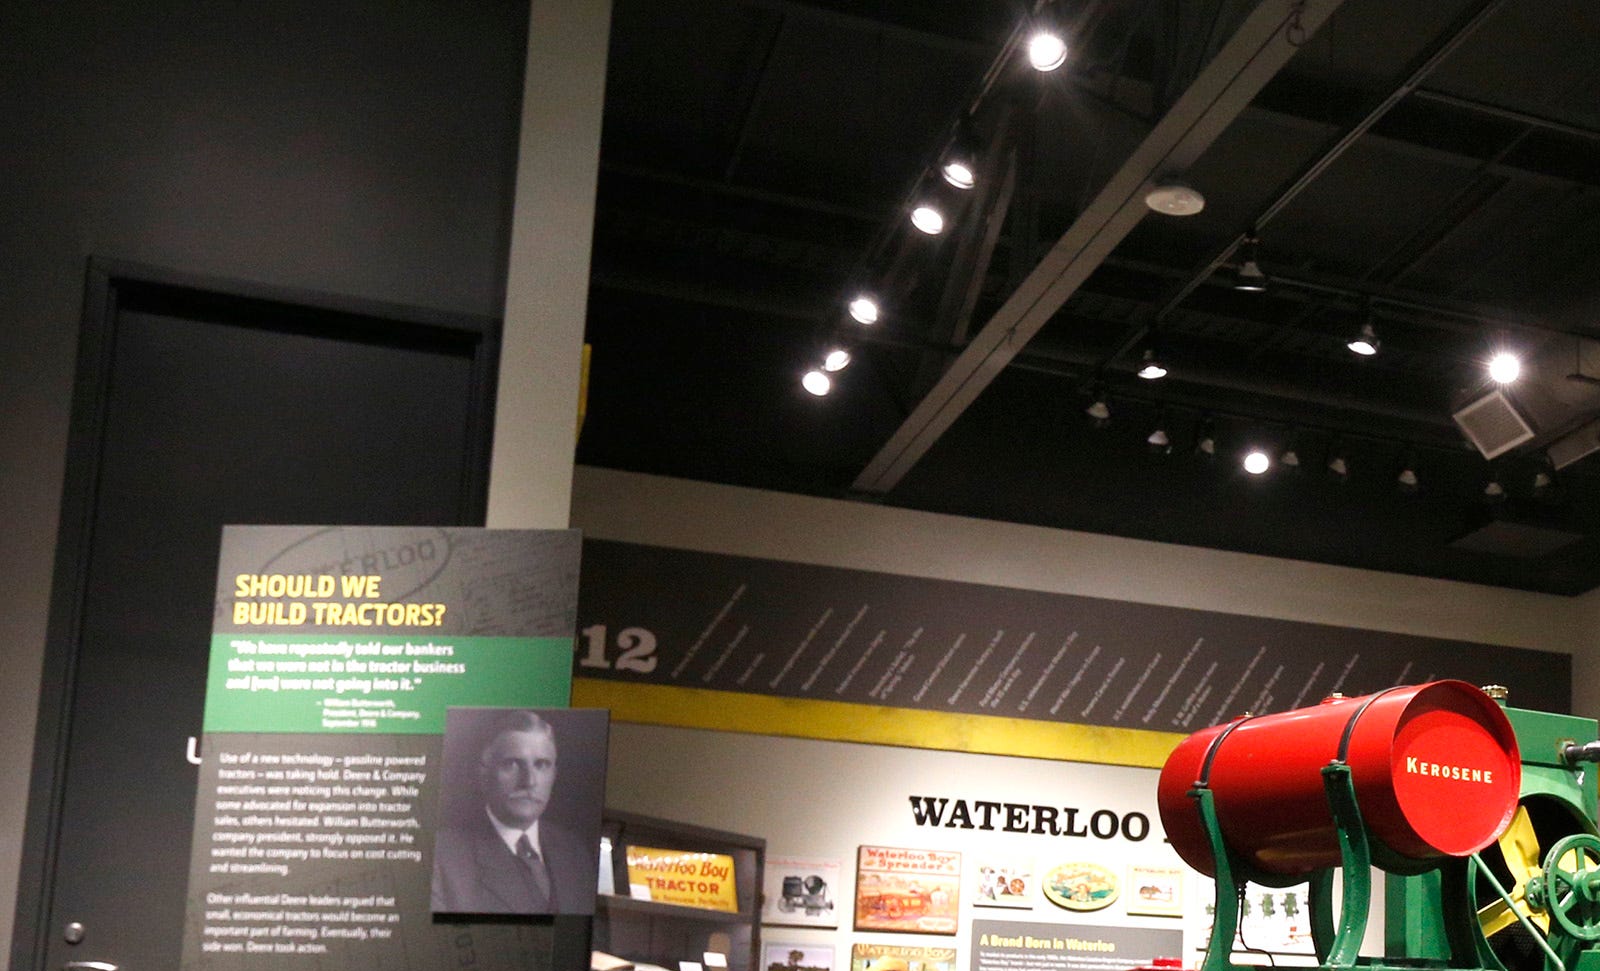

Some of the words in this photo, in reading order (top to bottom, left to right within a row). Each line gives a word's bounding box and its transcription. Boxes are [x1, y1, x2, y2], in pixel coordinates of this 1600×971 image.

[234, 574, 335, 598] SHOULD
[340, 575, 382, 598] WE
[232, 602, 307, 625] BUILD
[312, 603, 447, 626] TRACTORS?
[220, 752, 238, 764] Use
[260, 755, 281, 764] new
[281, 754, 333, 767] technology
[344, 754, 383, 767] gasoline
[384, 754, 426, 767] powered
[218, 769, 256, 779] tractors
[265, 770, 284, 779] was
[285, 769, 316, 783] taking
[343, 769, 371, 781] Deere
[382, 769, 426, 784] Company
[215, 801, 242, 810] some
[242, 800, 292, 811] advocated
[292, 800, 307, 811] for
[308, 802, 357, 812] expansion
[358, 802, 377, 812] into
[379, 802, 412, 812] tractor
[909, 796, 1150, 841] WATERLOO
[211, 847, 247, 858] wanted
[247, 847, 265, 858] the
[265, 848, 309, 861] company
[322, 846, 348, 860] focus
[364, 849, 386, 860] cost
[386, 850, 422, 863] cutting
[867, 849, 925, 861] Waterloo
[928, 852, 956, 864] Boy
[700, 861, 730, 881] Boy
[879, 858, 943, 872] Spreader
[645, 877, 719, 894] TRACTOR
[979, 934, 989, 947] A
[990, 935, 1023, 948] Brand
[1025, 936, 1051, 949] Born
[1066, 938, 1116, 952] Waterloo
